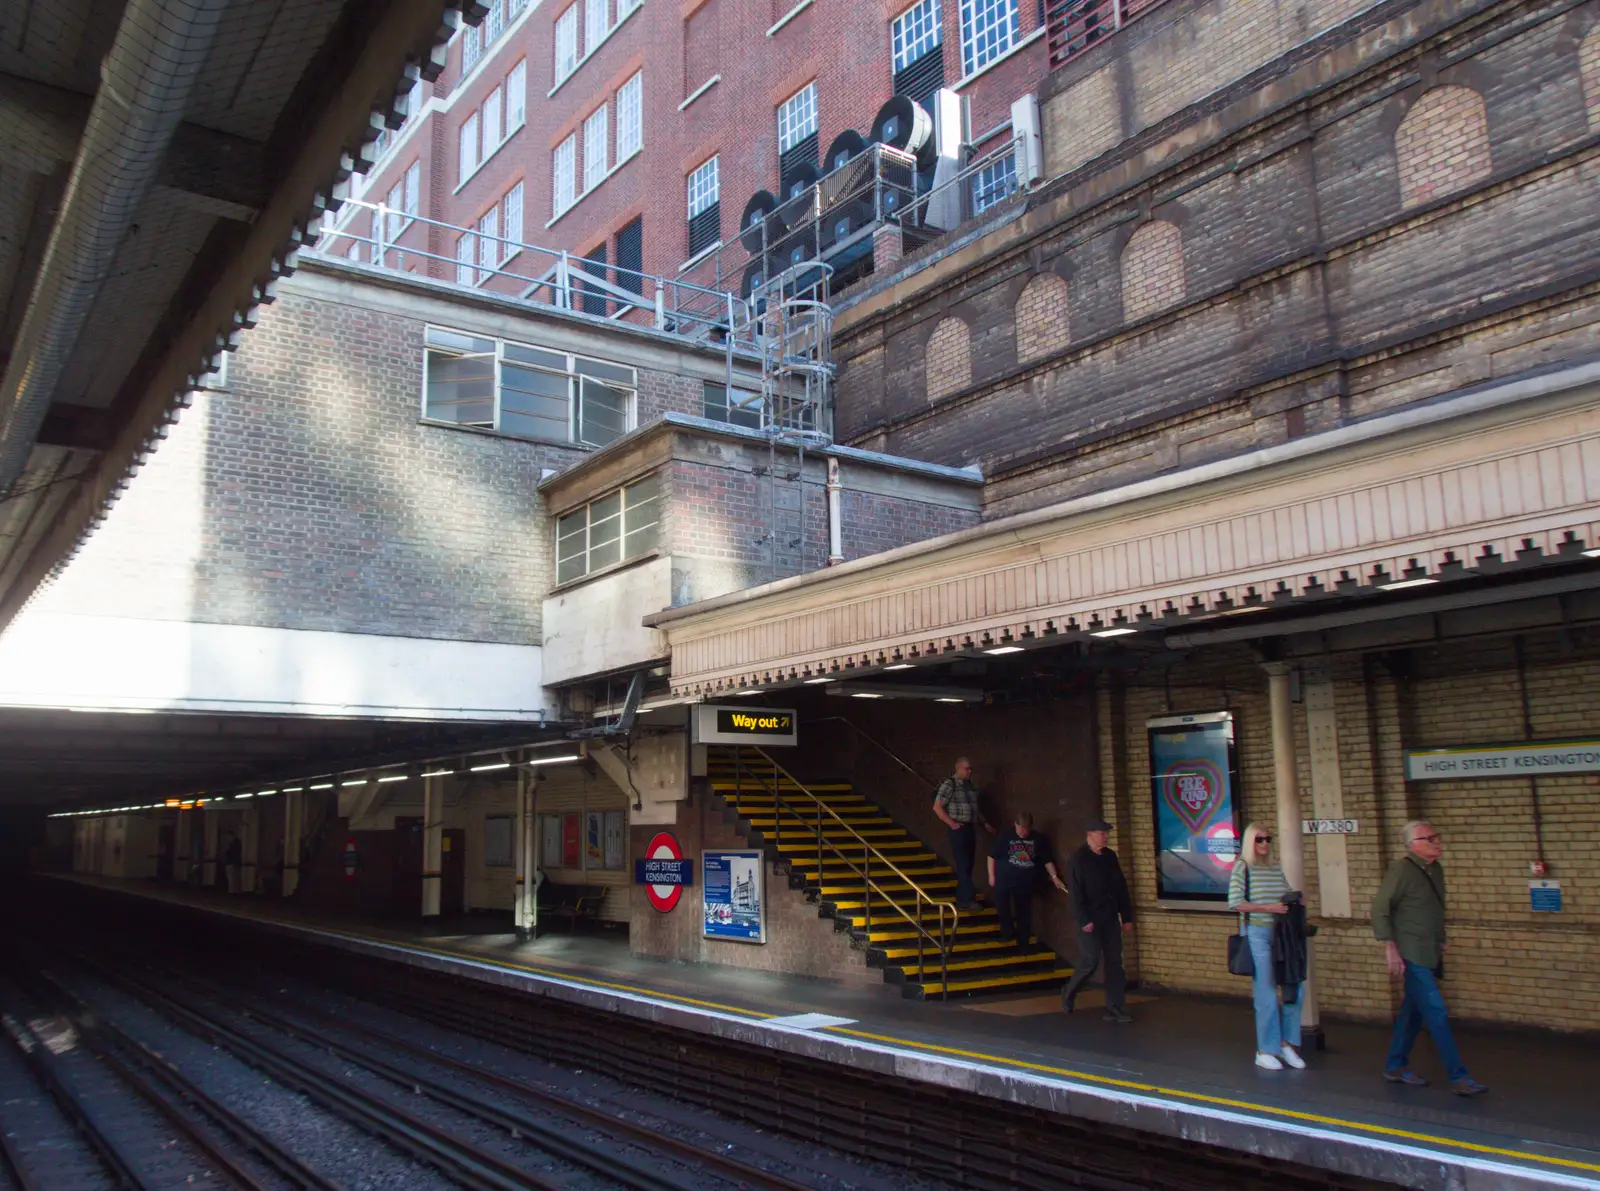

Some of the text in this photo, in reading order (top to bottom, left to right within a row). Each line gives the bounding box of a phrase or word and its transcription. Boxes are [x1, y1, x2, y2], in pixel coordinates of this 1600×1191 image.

[732, 714, 778, 730] Way out
[1425, 760, 1457, 772] HIGH
[1463, 757, 1508, 770] STREET
[1178, 775, 1205, 791] BE
[1181, 791, 1208, 804] KIND
[1307, 820, 1353, 833] W2380
[645, 861, 682, 871] HIGH STREET
[645, 872, 682, 883] KENSINGTON
